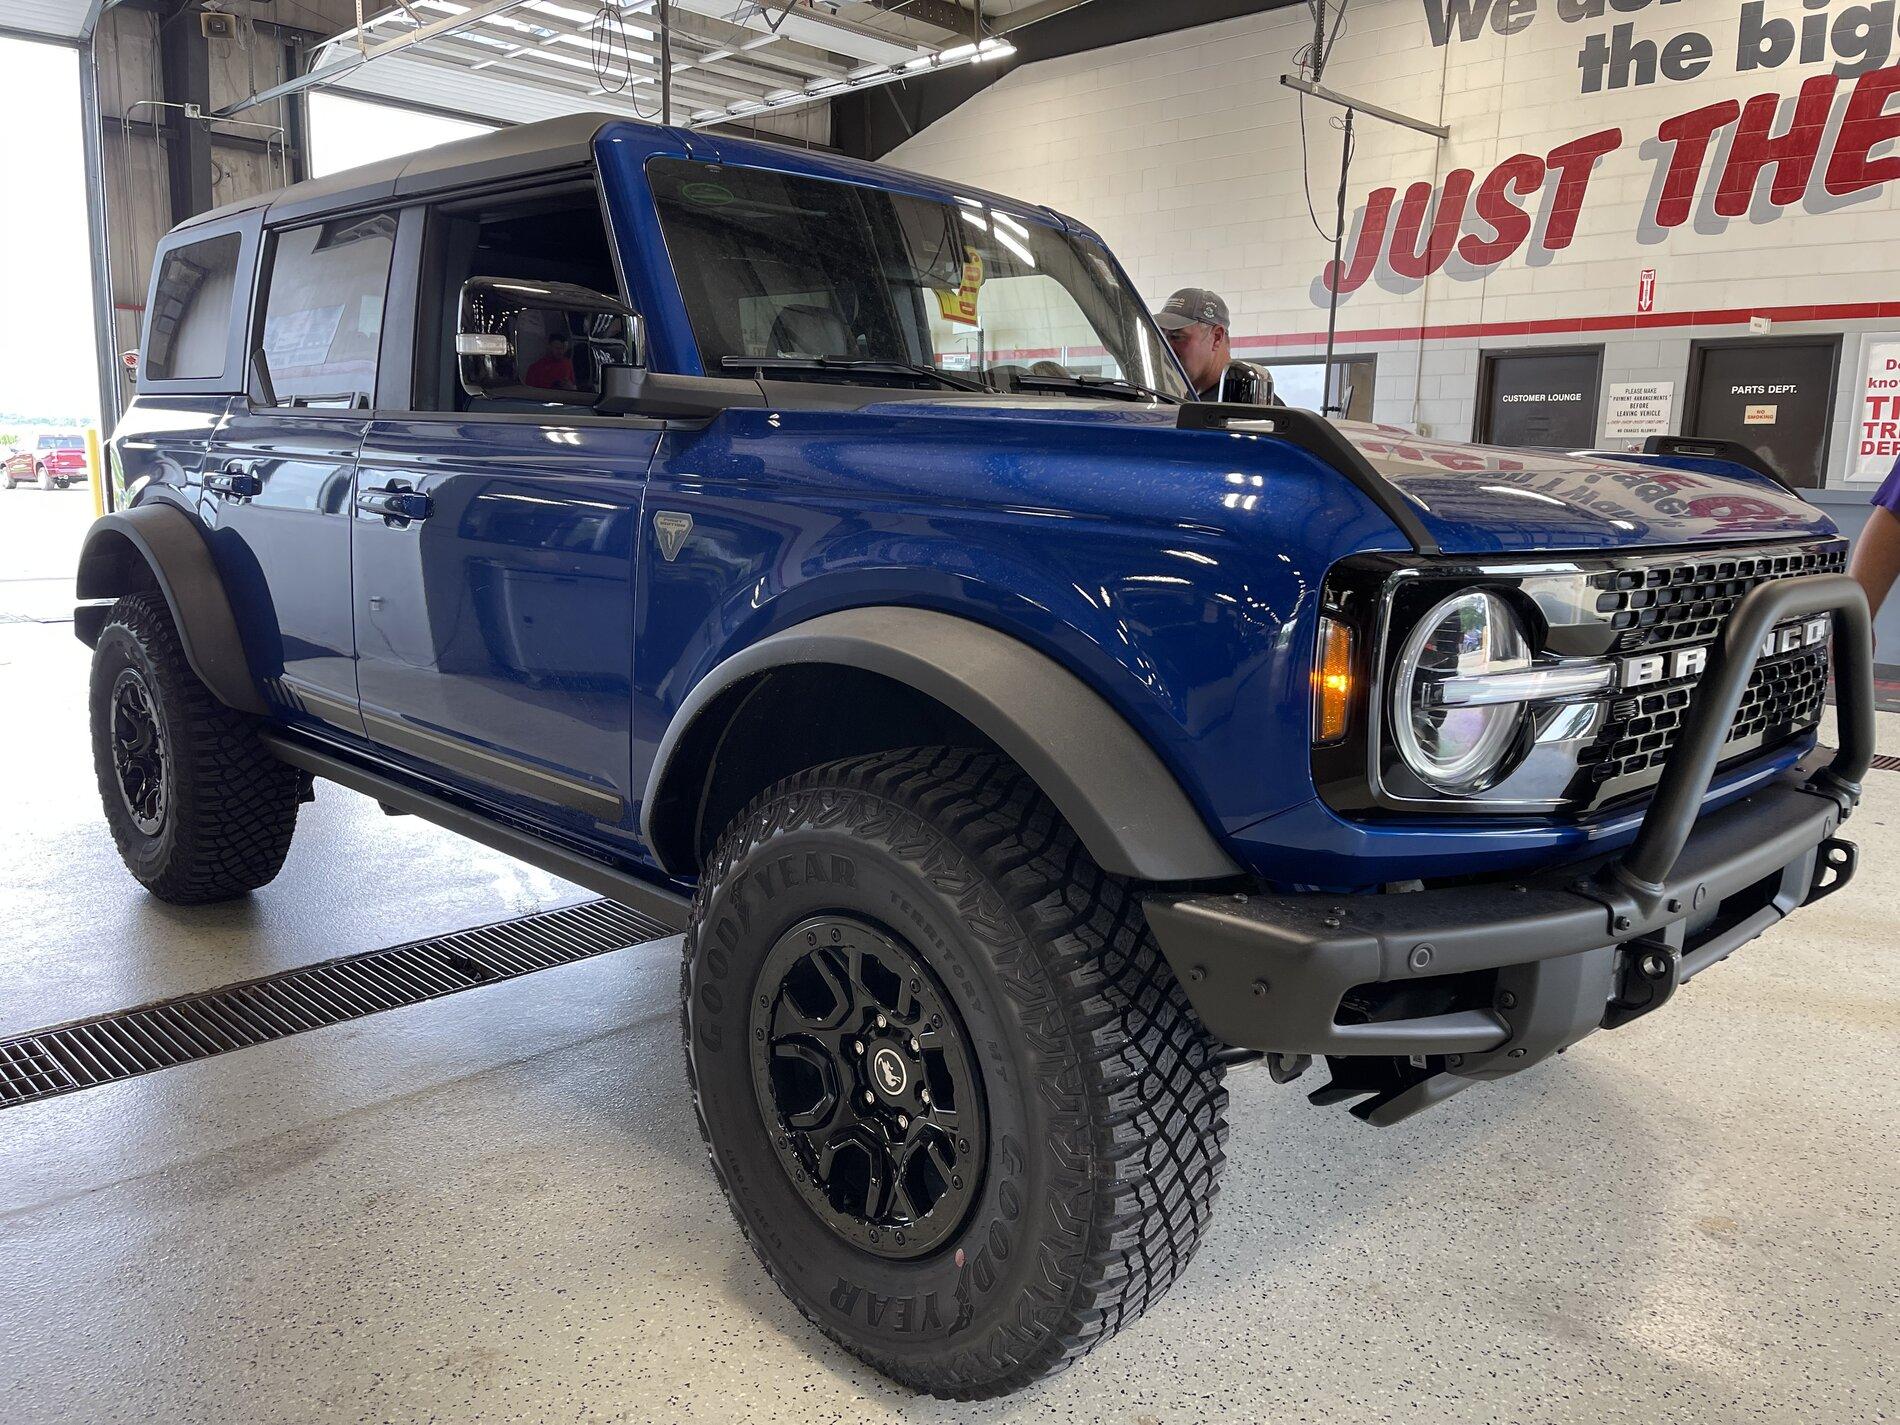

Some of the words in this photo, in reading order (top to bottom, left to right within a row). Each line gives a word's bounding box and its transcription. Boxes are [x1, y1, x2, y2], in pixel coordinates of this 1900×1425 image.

[1422, 0, 1537, 47] We
[1578, 22, 1713, 94] the
[1736, 0, 1900, 80] big
[1322, 127, 1623, 294] JUST
[1657, 65, 1900, 228] THE
[959, 252, 980, 317] SOLD
[1502, 394, 1546, 403] CUSTOMER
[1547, 393, 1582, 402] LOUNGE
[1731, 385, 1765, 395] PARTS
[1768, 385, 1797, 394] DEPT.
[1868, 378, 1900, 389] kno
[1863, 422, 1900, 439] TR
